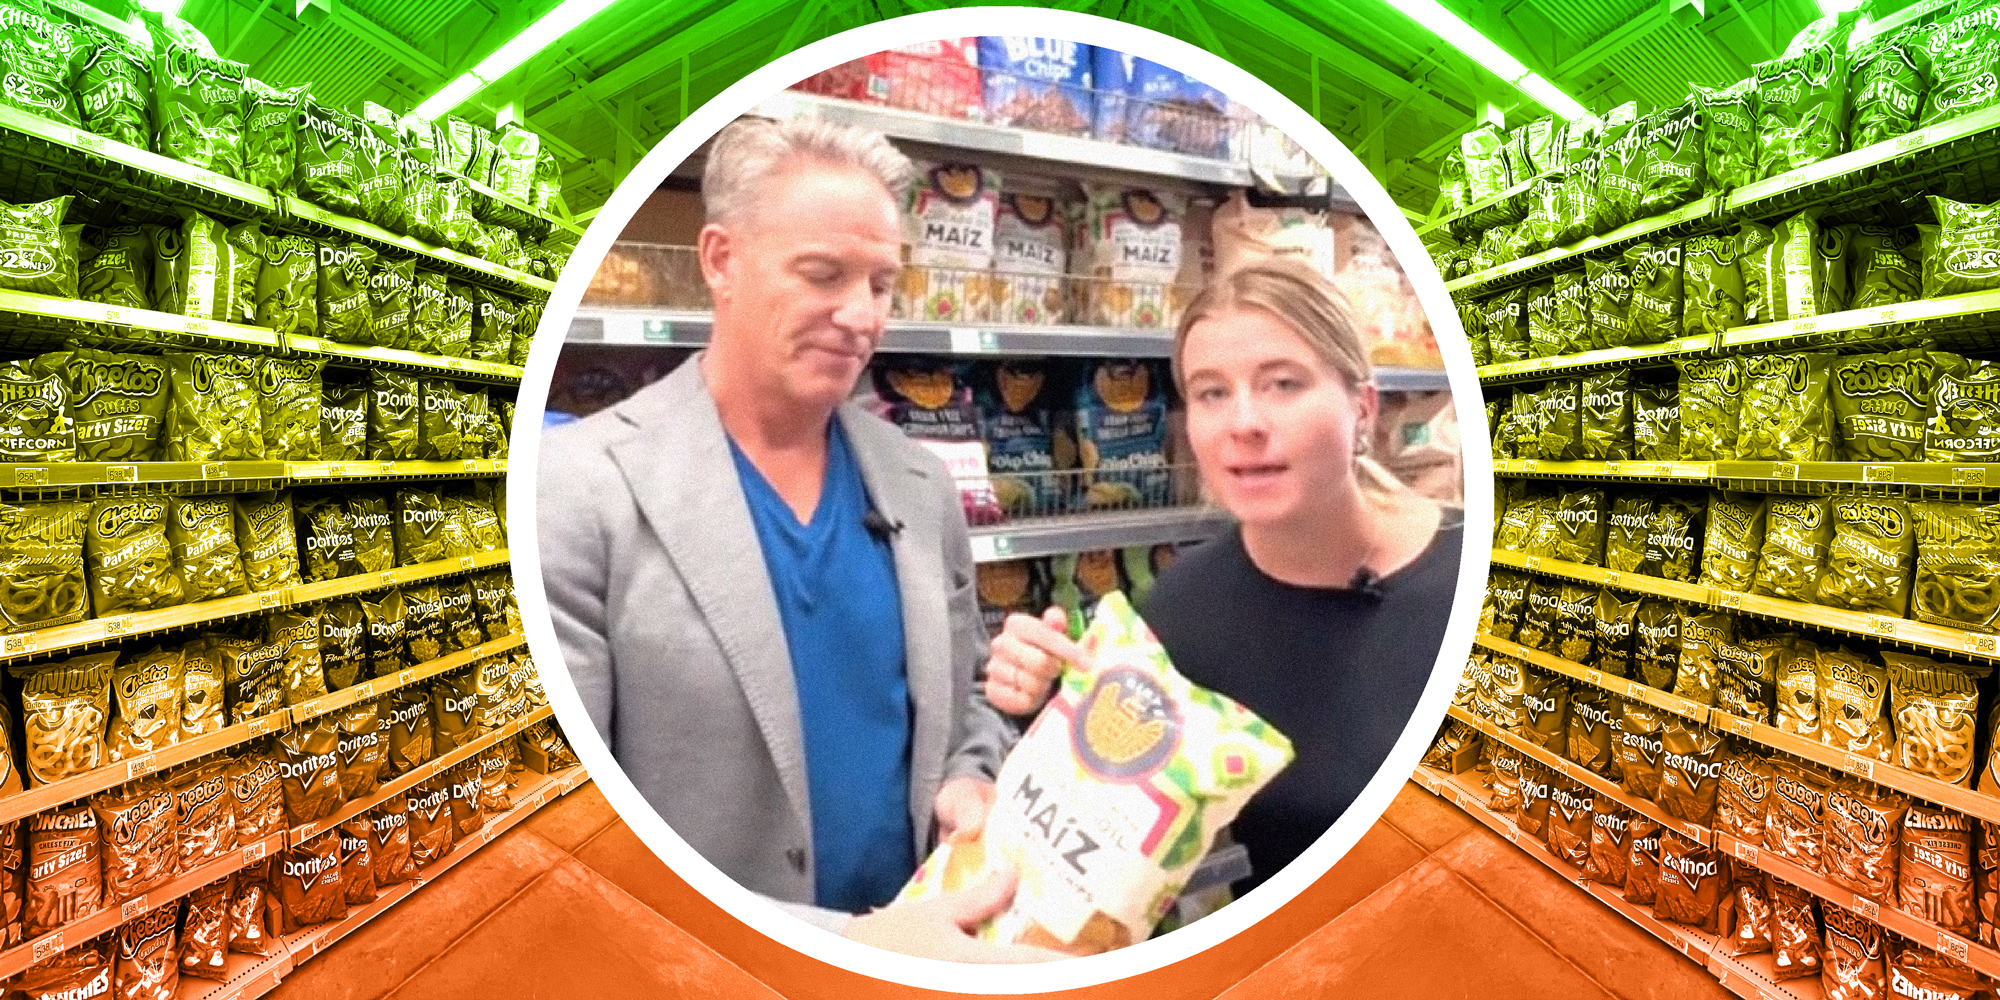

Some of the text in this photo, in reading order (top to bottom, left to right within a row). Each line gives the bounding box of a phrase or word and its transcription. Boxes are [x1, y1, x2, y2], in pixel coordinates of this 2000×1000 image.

[377, 391, 419, 407] Dorito
[93, 400, 140, 415] Puffs
[322, 405, 365, 421] oritos
[78, 418, 149, 440] arty Size!
[0, 438, 67, 449] UFFCORN
[17, 473, 34, 482] 258
[108, 471, 122, 480] 538
[99, 504, 162, 536] Cheetos
[249, 502, 285, 527] heetos
[403, 509, 445, 523] Dorito
[187, 538, 214, 557] Party
[307, 533, 353, 550] Doritos
[103, 549, 133, 568] Party
[253, 541, 277, 560] Party
[443, 593, 472, 607] Dorit
[106, 621, 121, 632] 538
[323, 622, 362, 638] Doritos
[7, 640, 22, 651] 538
[275, 622, 319, 655] Cheeto
[237, 645, 281, 676] Cheetos
[121, 664, 170, 699] Cheetos
[136, 682, 169, 698] MEXICAN
[337, 731, 378, 753] oritos
[133, 762, 145, 773] 438
[280, 751, 336, 778] Doritos
[236, 760, 281, 801] Cheetos
[407, 787, 449, 812] Doritos
[39, 840, 75, 850] CHEESE FIX
[32, 846, 87, 879] arty Size!
[283, 851, 338, 877] Doritos
[124, 904, 137, 916] 438
[36, 943, 50, 958] 538
